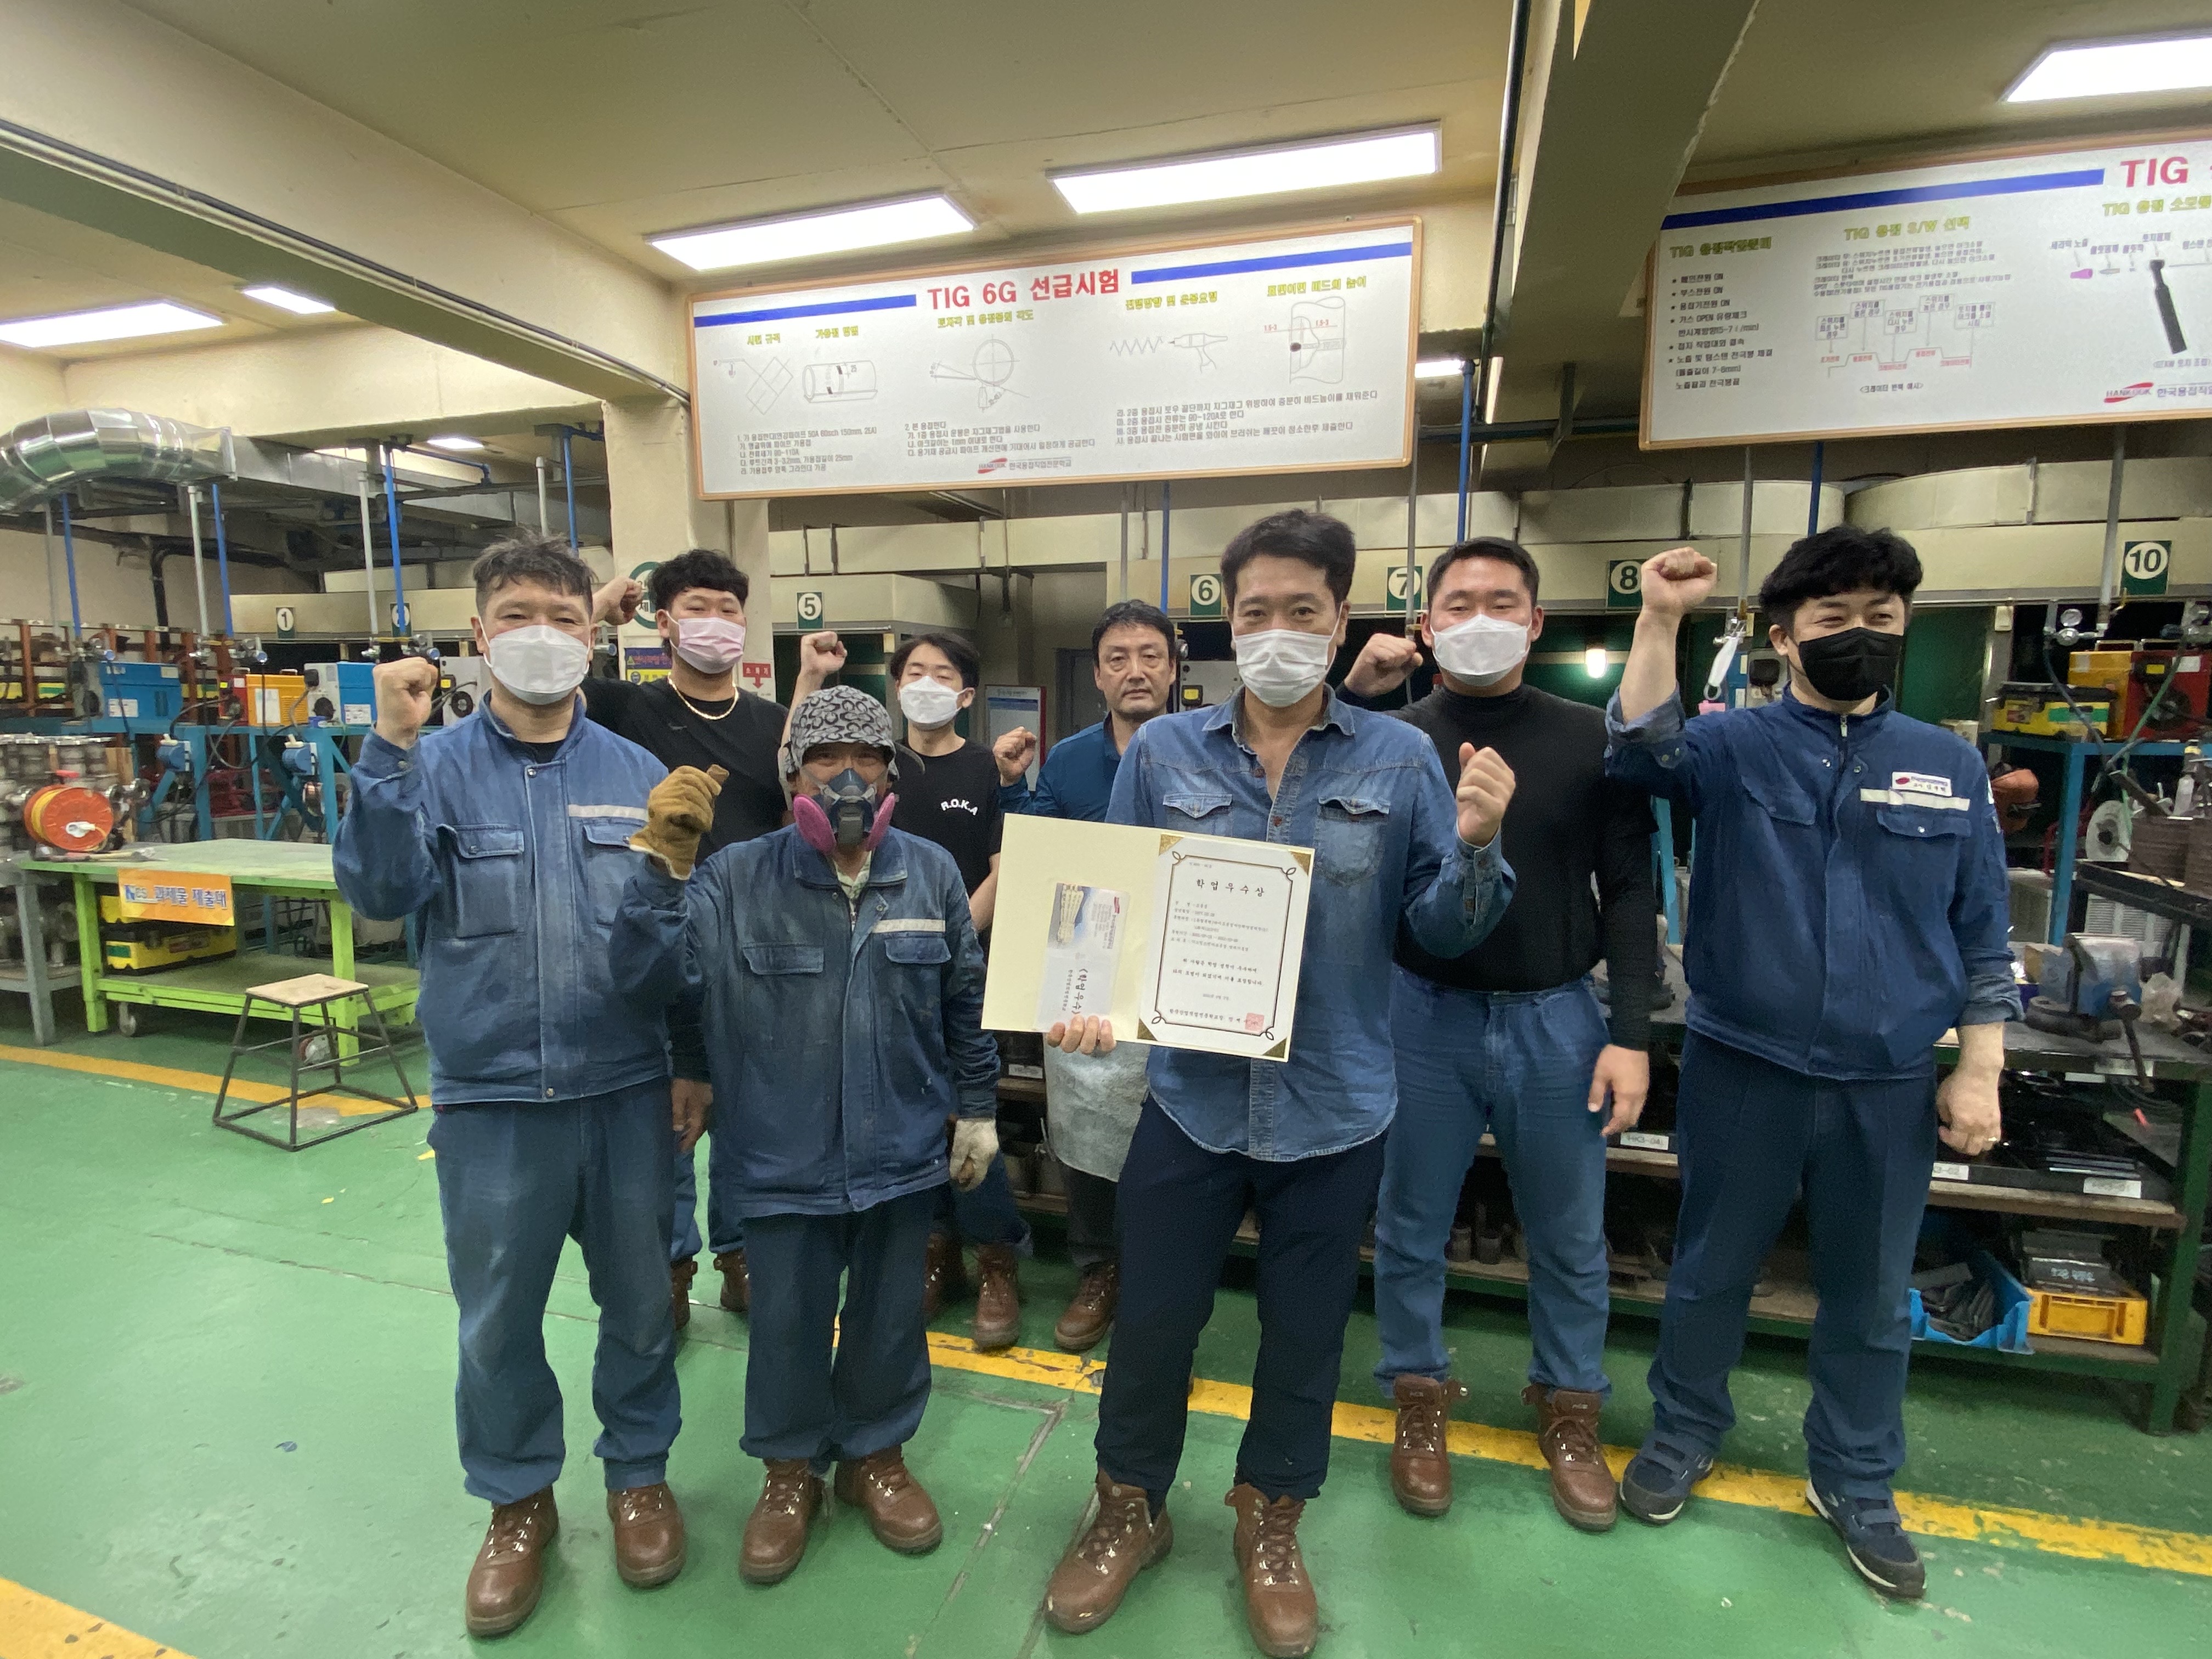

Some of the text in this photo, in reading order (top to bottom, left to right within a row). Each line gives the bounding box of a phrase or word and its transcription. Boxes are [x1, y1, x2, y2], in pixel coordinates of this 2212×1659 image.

[2120, 156, 2189, 188] TIG
[1844, 227, 1870, 241] TIG
[1669, 245, 1694, 258] TIG
[928, 269, 1119, 309] TIG 6G 선급시험
[1214, 400, 1243, 411] 지그재그
[1014, 424, 1040, 433] 사용한다
[2129, 549, 2162, 573] 10
[1620, 565, 1638, 590] 8
[1198, 579, 1214, 602] 6
[804, 597, 815, 616] 5
[281, 611, 289, 628] 1
[941, 798, 978, 816] R.O.K.A
[191, 888, 228, 910] 제출대
